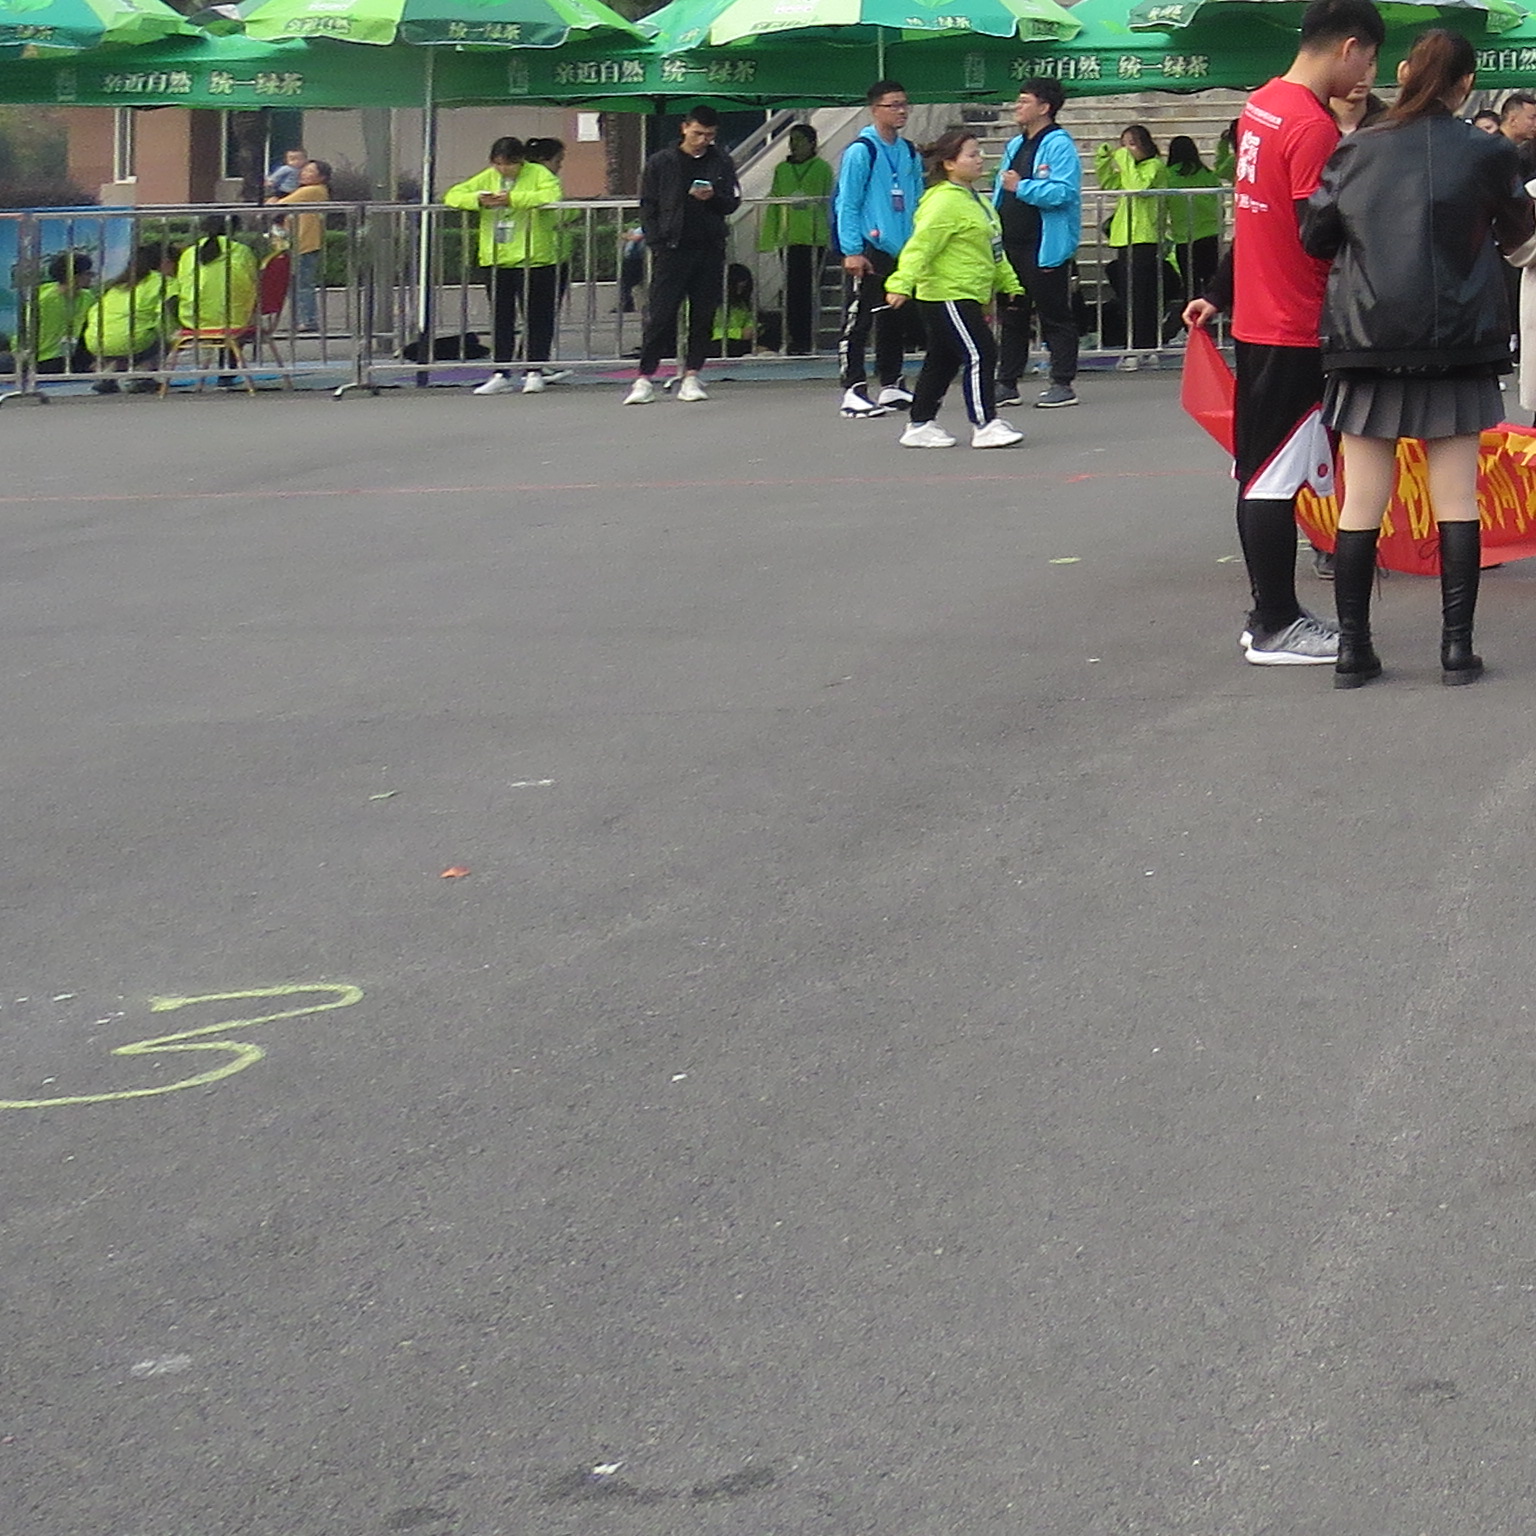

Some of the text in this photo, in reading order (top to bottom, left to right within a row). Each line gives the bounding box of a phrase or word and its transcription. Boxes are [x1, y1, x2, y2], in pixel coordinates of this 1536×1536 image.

[661, 60, 756, 84] 统一绿茶
[1118, 54, 1210, 78] 统一绿茶
[208, 70, 304, 96] 统一绿茶
